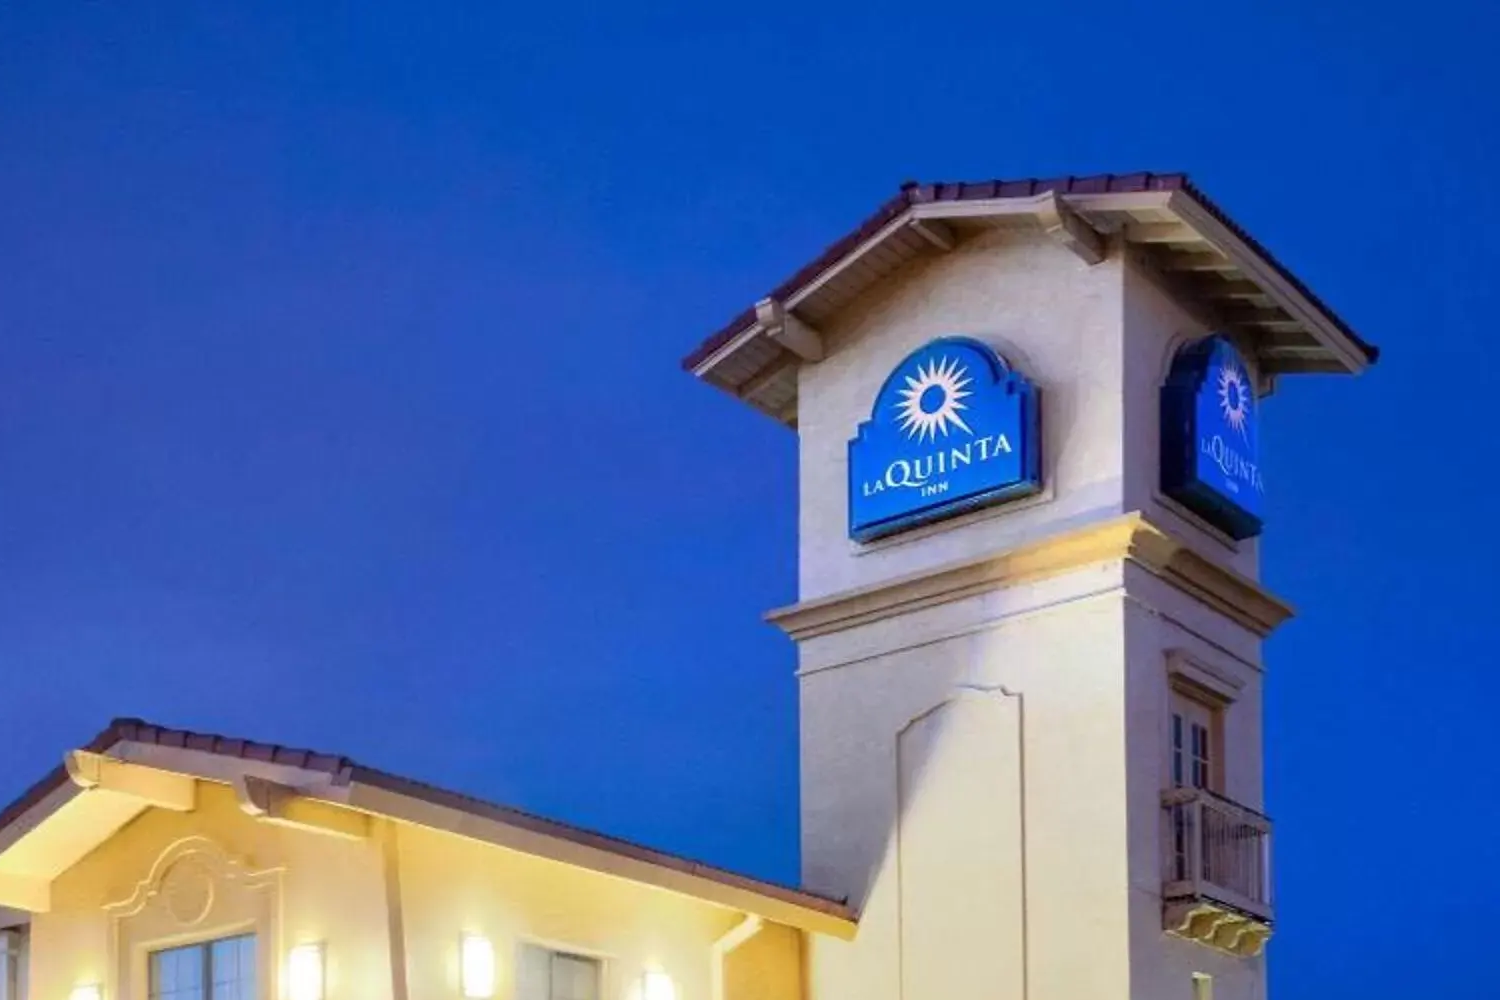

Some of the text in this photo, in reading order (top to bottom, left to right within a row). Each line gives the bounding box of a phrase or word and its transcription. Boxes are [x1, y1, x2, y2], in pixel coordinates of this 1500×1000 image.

[863, 433, 1012, 497] LA QUINTA
[921, 481, 948, 497] INN
